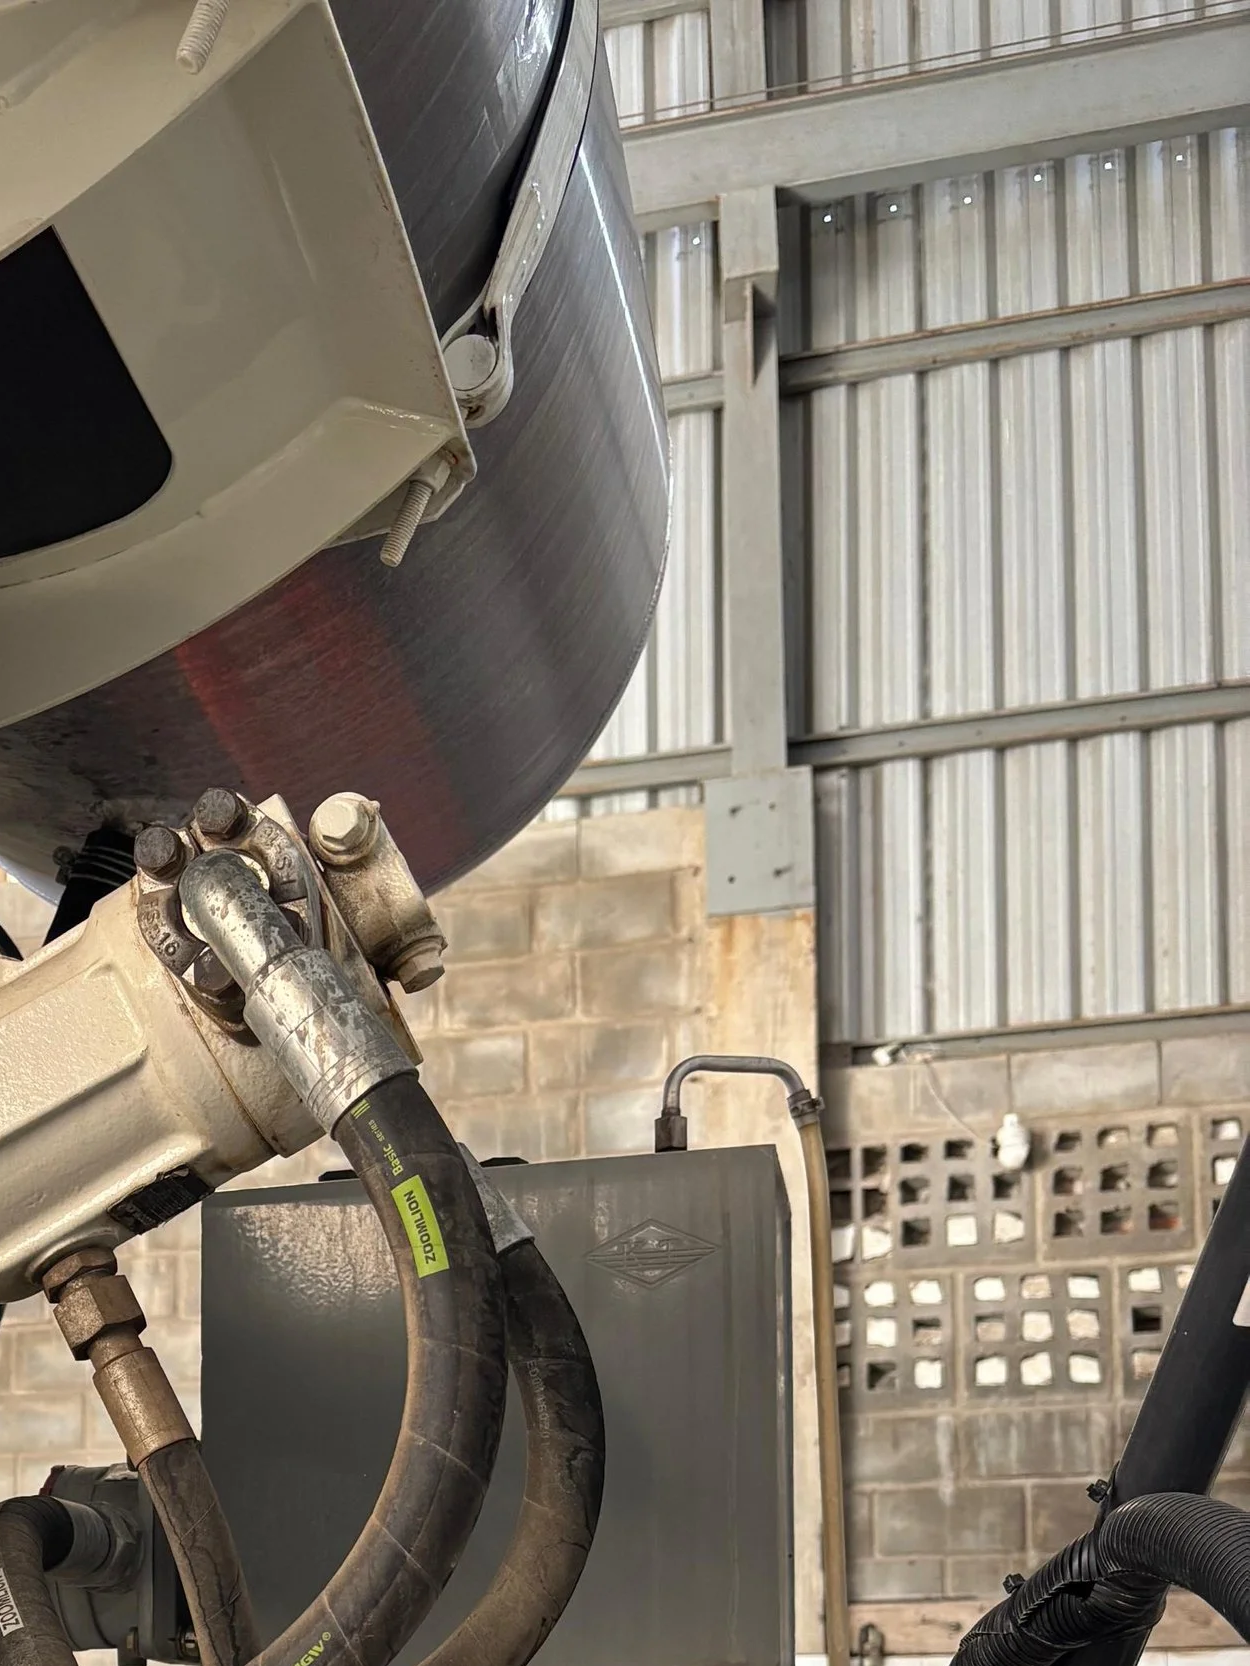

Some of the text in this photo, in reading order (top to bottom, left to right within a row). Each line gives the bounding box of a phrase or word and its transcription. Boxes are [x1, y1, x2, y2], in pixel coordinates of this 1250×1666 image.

[367, 1118, 437, 1265] ZOOMLION Basic series
